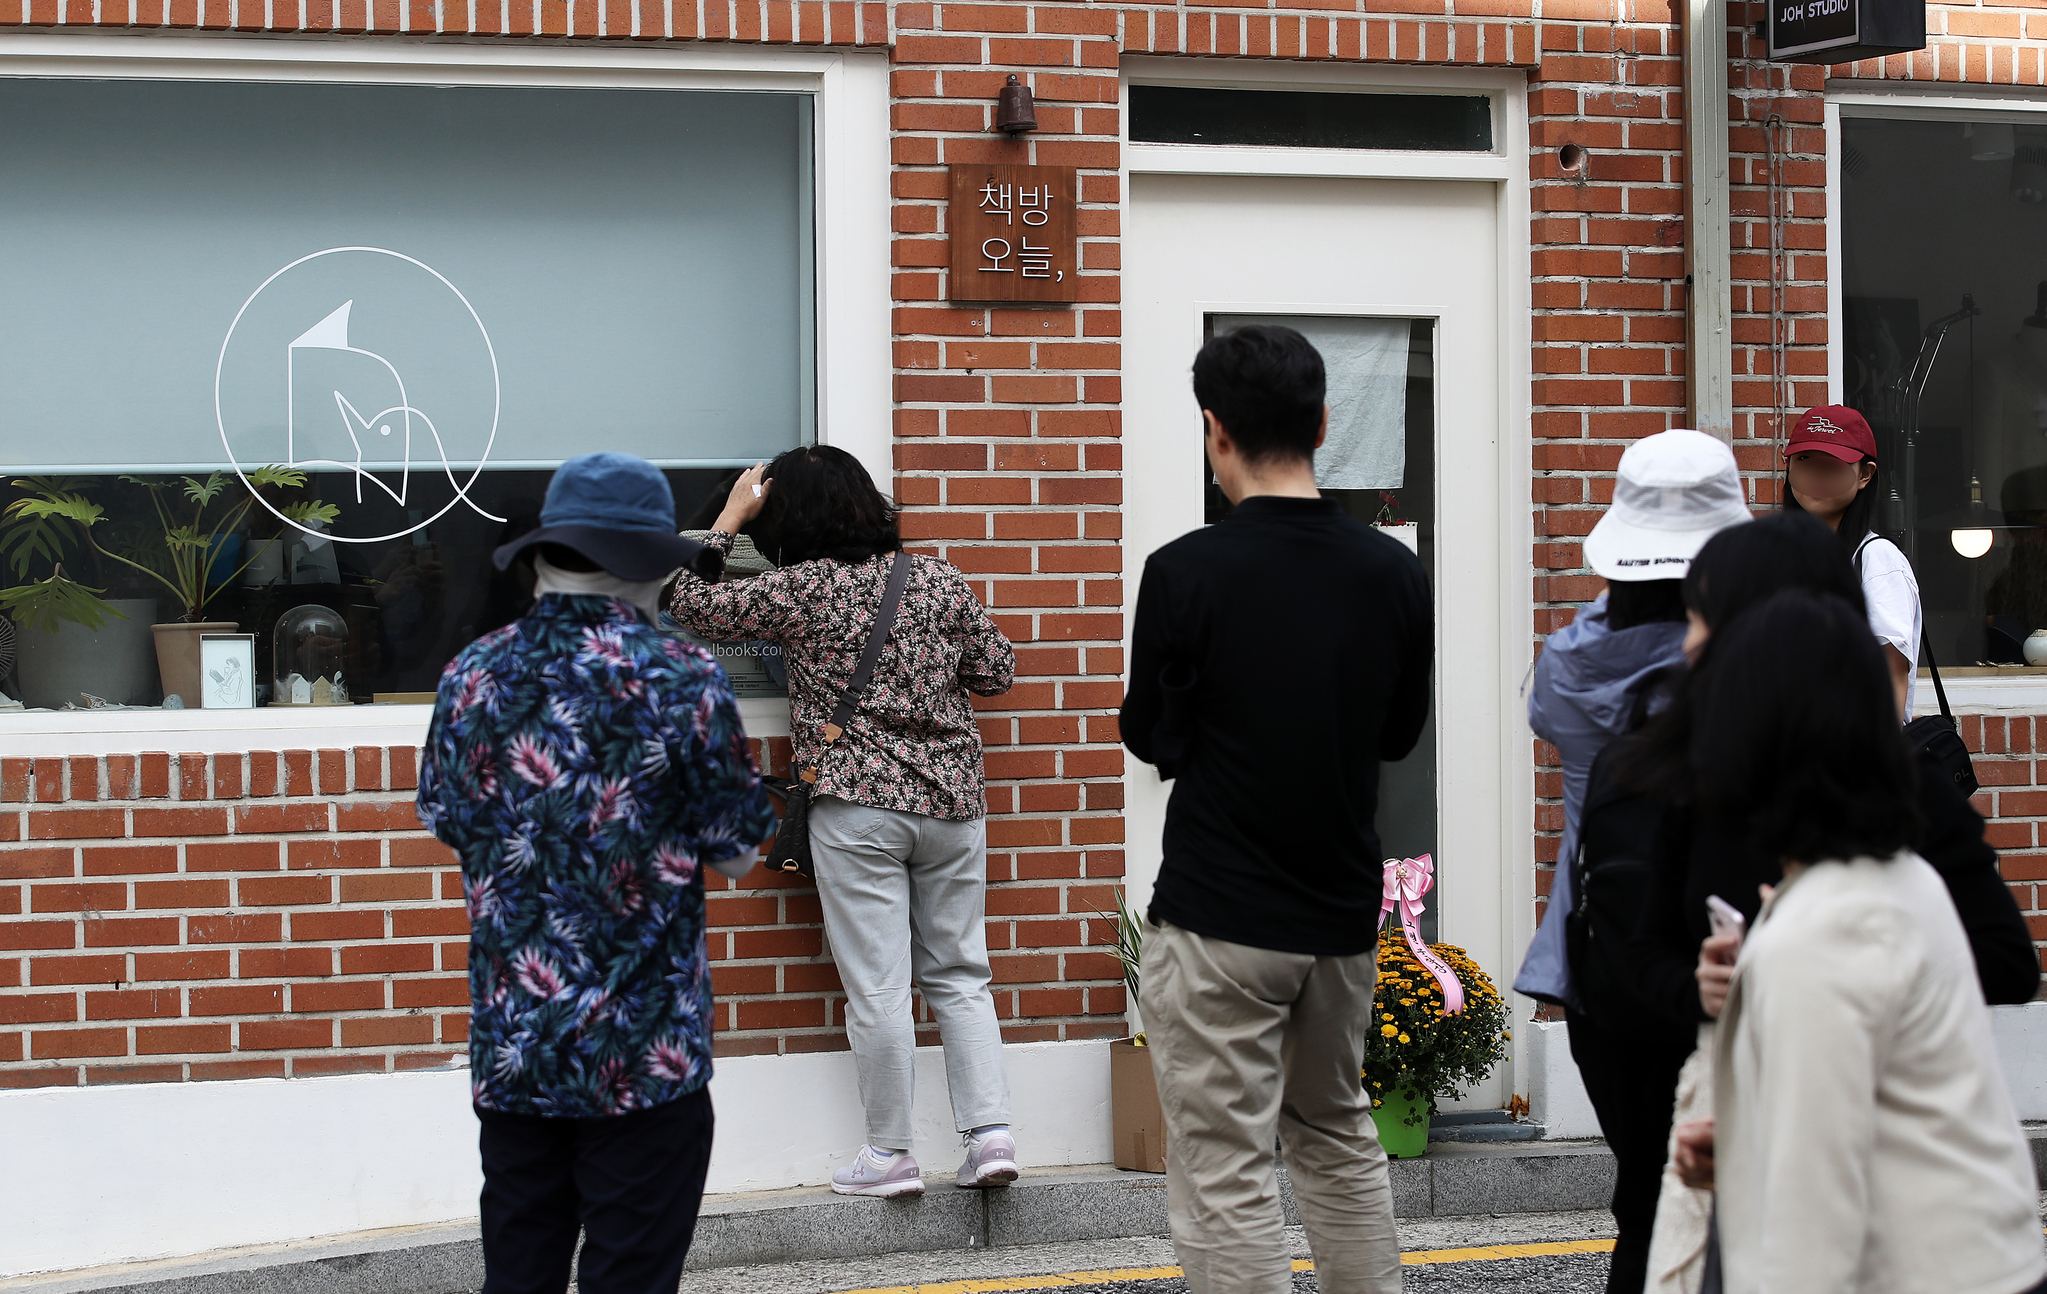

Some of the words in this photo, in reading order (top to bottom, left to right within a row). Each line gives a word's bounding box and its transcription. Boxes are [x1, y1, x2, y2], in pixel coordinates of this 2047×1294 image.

[1781, 5, 1804, 23] JOH
[1808, 0, 1849, 18] STUDIO
[978, 183, 1055, 226] 책방
[978, 236, 1064, 282] 오늘,
